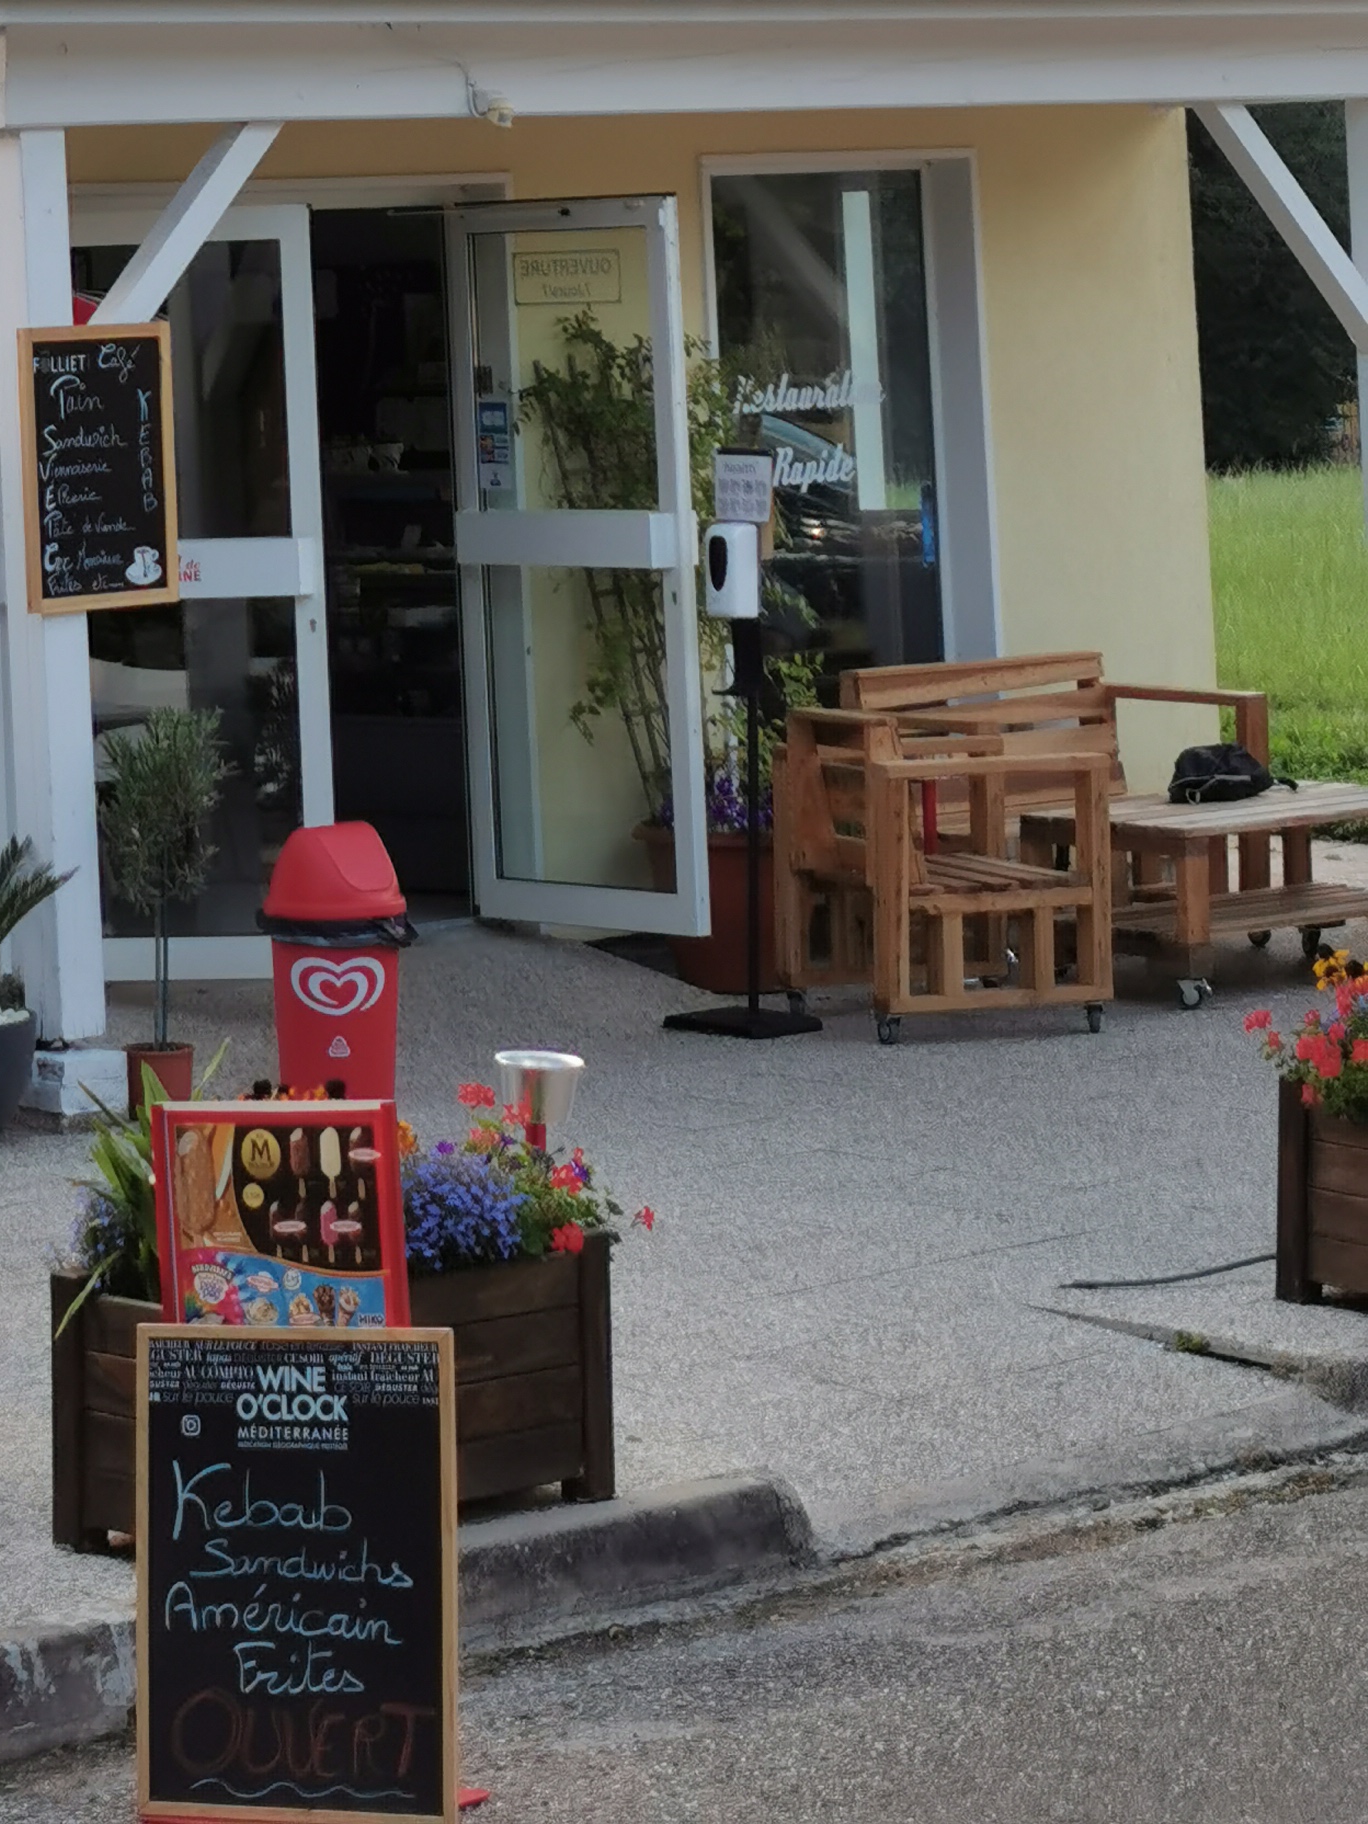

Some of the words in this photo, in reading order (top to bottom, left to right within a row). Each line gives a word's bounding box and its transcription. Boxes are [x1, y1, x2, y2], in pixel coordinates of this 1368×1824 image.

[97, 343, 141, 383] Café
[49, 374, 105, 421] Pain
[732, 370, 888, 416] Restaurat
[42, 422, 129, 457] Sandwich
[136, 387, 159, 513] KEBAB
[772, 441, 857, 495] Rapide
[256, 1364, 326, 1393] WINE
[236, 1392, 350, 1422] O'CLOCK
[236, 1423, 350, 1441] MÉDITERRANÉE
[172, 1459, 353, 1542] Kebab
[189, 1537, 415, 1589] Sandwichs
[164, 1580, 404, 1647] Américain
[232, 1640, 366, 1696] Frites
[171, 1685, 437, 1779] OUVERT
